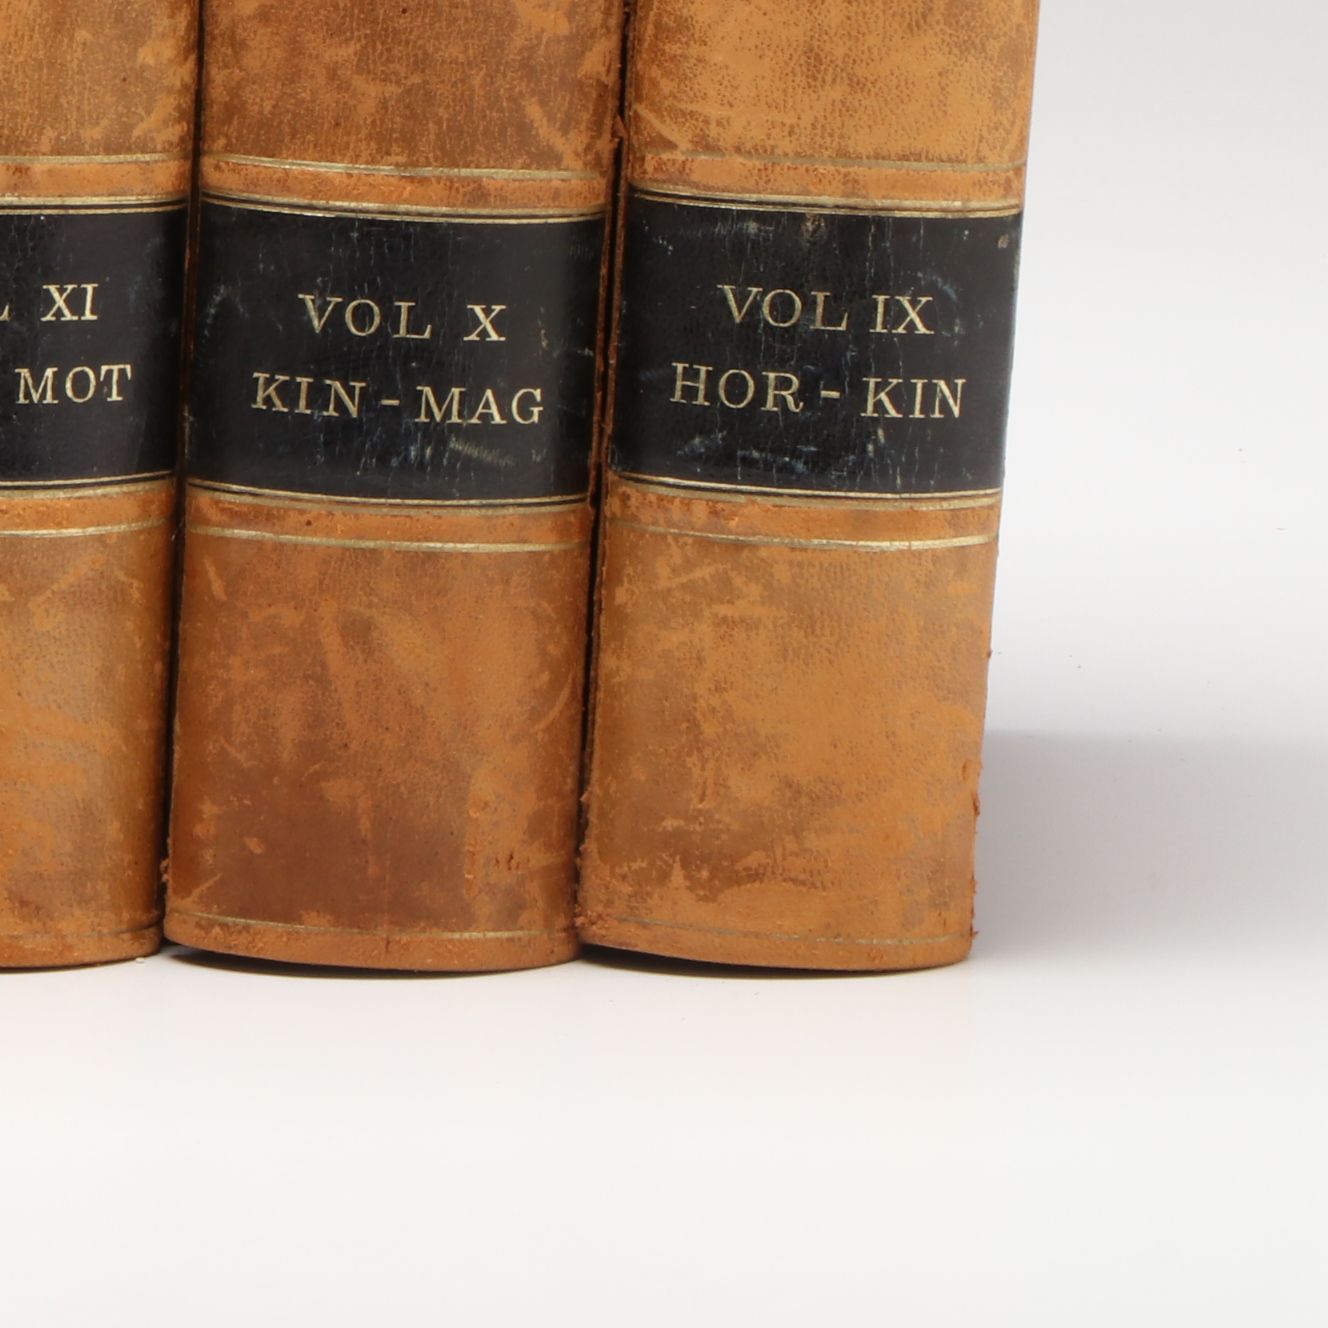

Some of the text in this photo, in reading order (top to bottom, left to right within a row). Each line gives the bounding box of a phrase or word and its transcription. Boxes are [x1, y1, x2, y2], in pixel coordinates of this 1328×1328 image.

[40, 283, 98, 321] XI
[297, 294, 506, 342] VOL X
[717, 284, 935, 335] VOL IX
